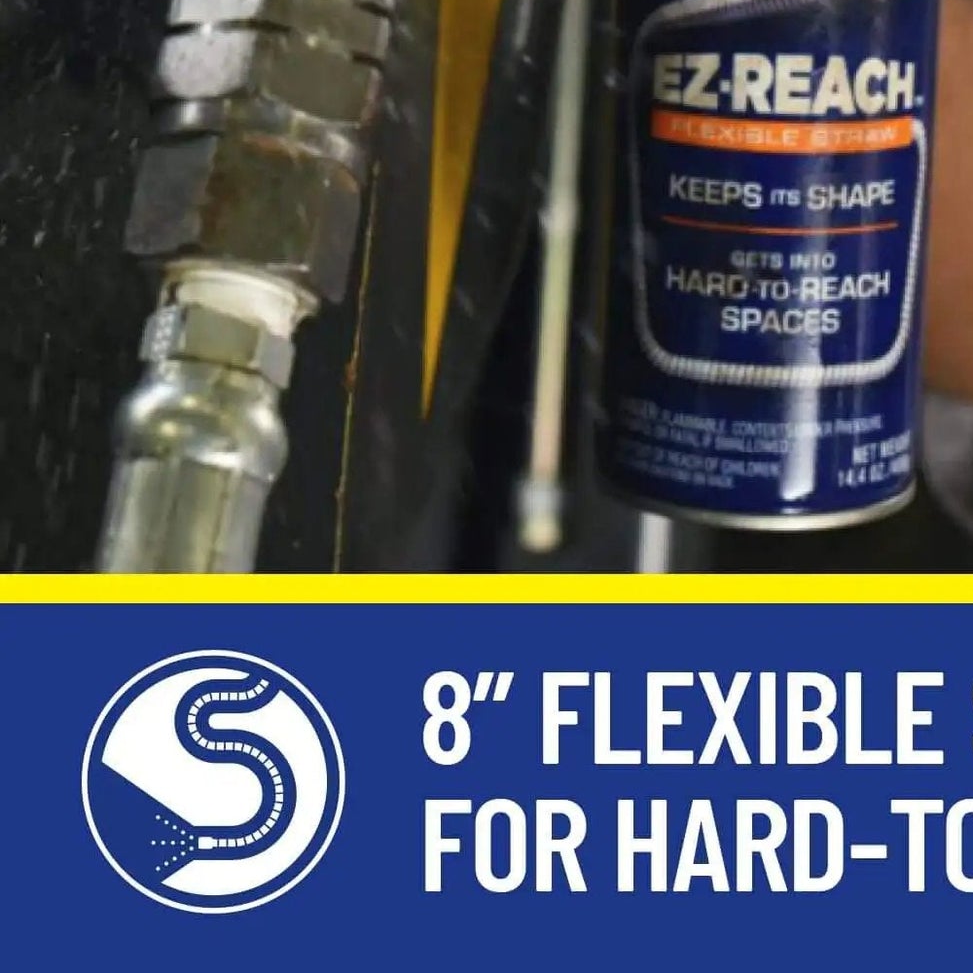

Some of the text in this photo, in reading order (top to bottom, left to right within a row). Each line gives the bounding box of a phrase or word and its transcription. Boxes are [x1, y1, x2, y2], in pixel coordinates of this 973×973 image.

[653, 52, 915, 115] EZ-REACH
[671, 120, 897, 146] FLEXIBLE STRAW
[669, 174, 895, 210] KEEPS ITS SHAPE
[730, 250, 835, 271] GETS INTO
[665, 265, 891, 302] HARD-TO-REACH
[720, 305, 841, 335] SPACES
